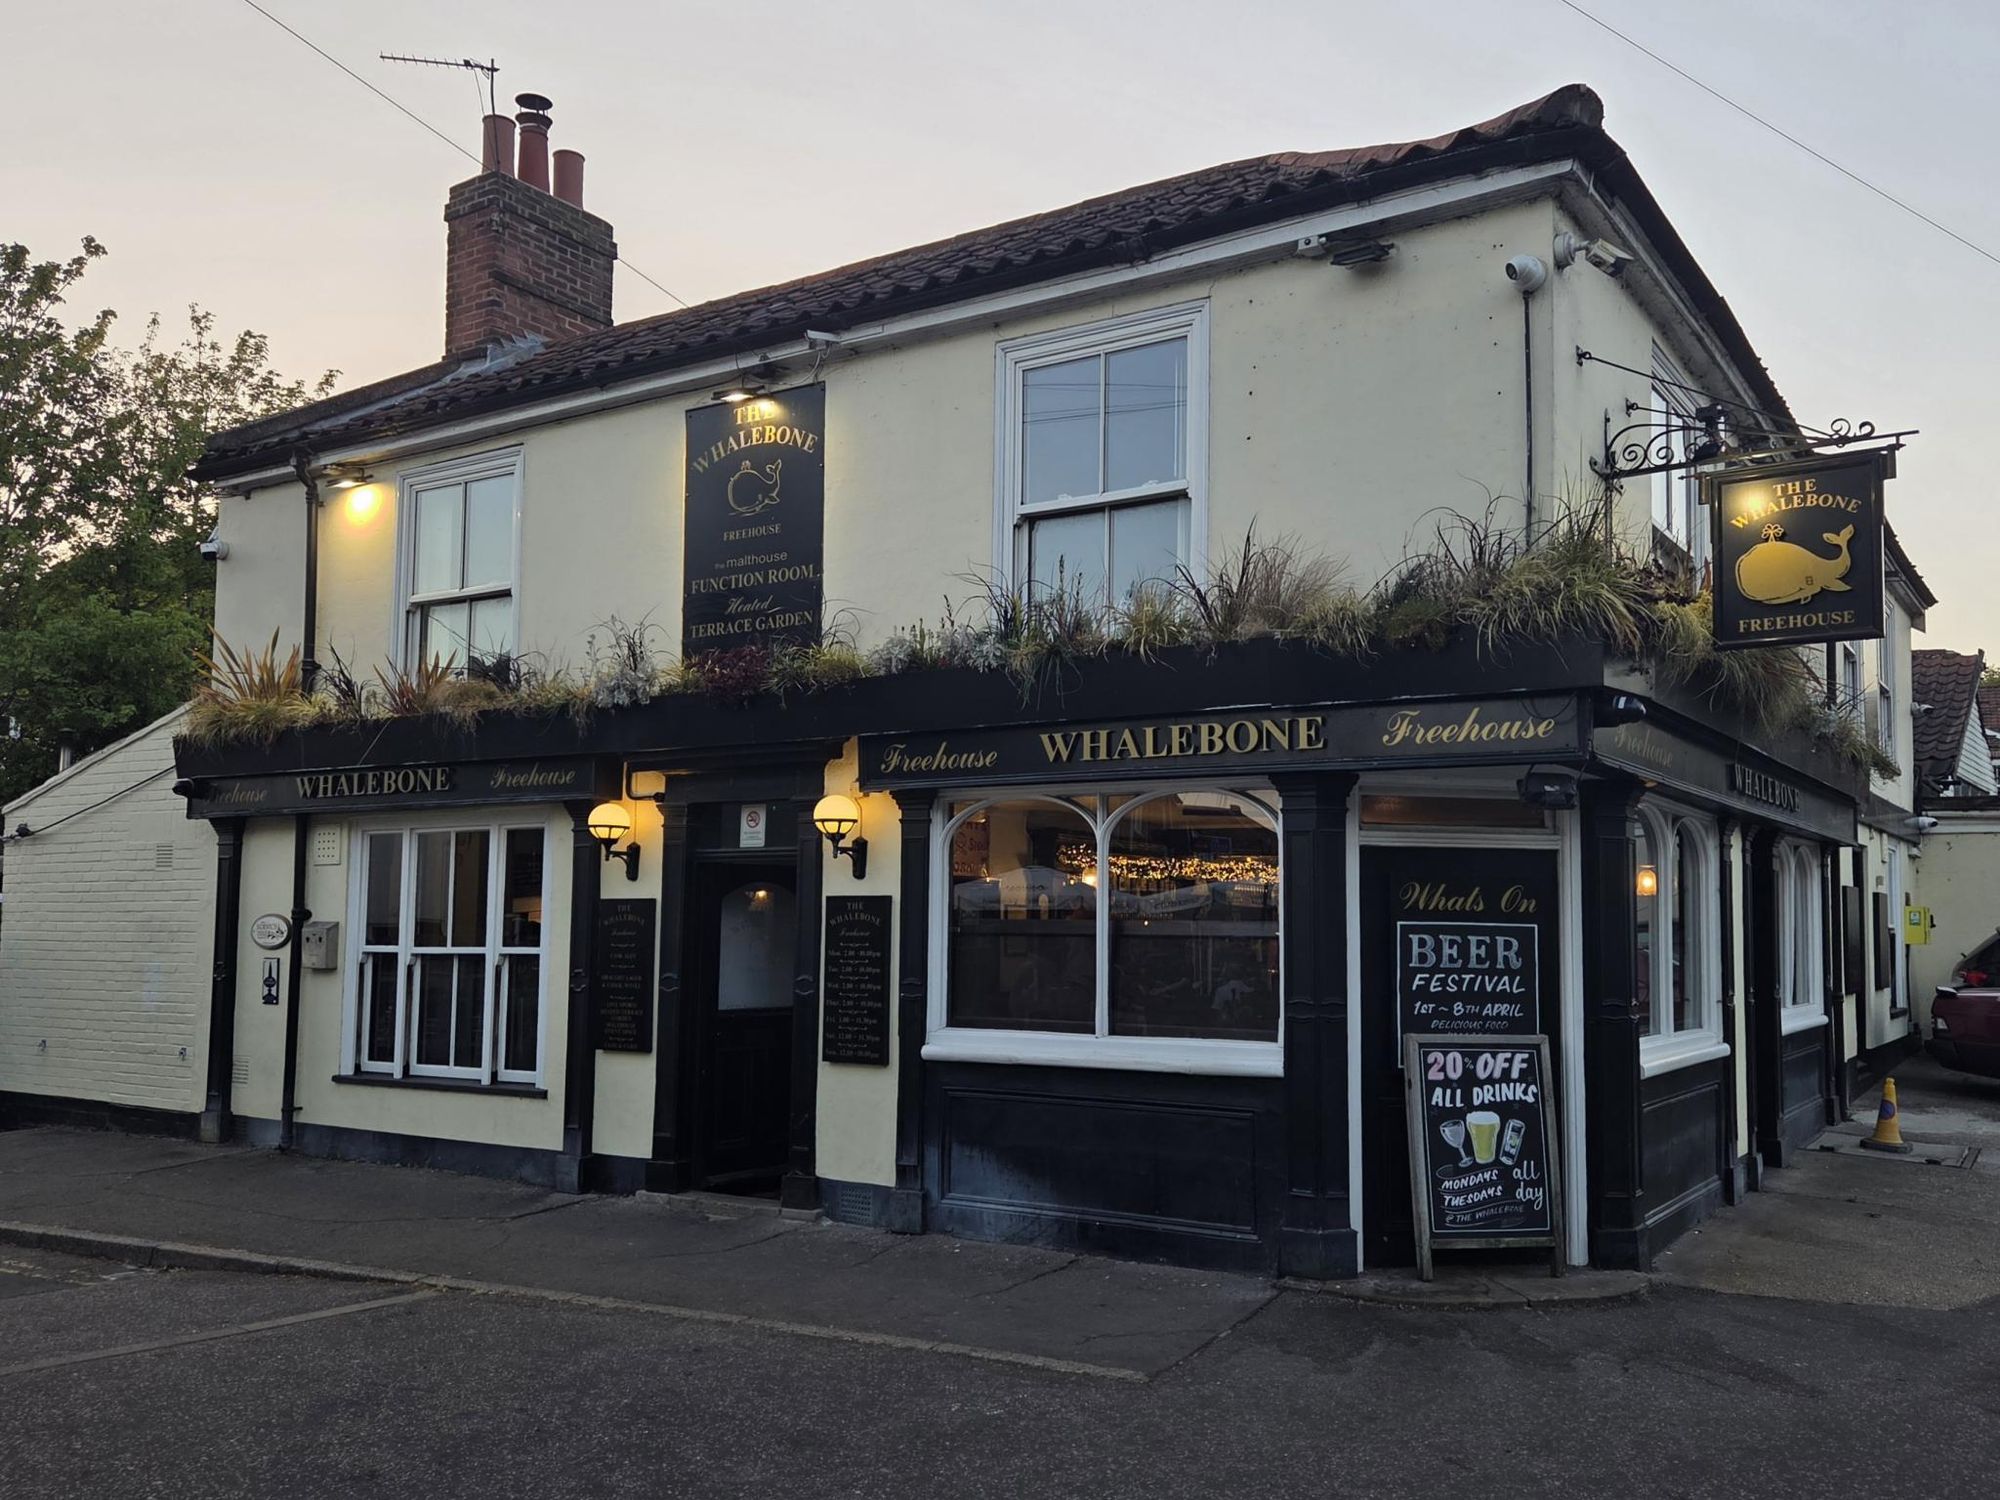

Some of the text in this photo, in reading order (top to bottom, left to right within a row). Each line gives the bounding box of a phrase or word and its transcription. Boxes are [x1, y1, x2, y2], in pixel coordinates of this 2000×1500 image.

[733, 401, 777, 425] THE
[691, 425, 818, 474] WHALEBONE
[1773, 478, 1817, 497] THE
[1730, 493, 1862, 530] WHALEBONE
[723, 523, 782, 541] FREEHOUSE
[726, 551, 788, 568] malthouse
[691, 564, 814, 595] FUNCTION ROOM
[724, 595, 783, 615] Heated
[690, 610, 814, 638] TERRACE GARDEN
[1739, 610, 1856, 633] FREEHOUSE
[1382, 707, 1557, 747] Freehouse
[1038, 716, 1327, 764] WHALEBONE
[880, 743, 999, 774] Freehouse
[296, 767, 451, 799] WHALEBONE
[489, 765, 578, 789] Freehouse
[1734, 763, 1801, 813] WHALEBONE
[847, 901, 864, 911] THE
[1500, 885, 1537, 913] On
[829, 911, 880, 928] WHALEBONE
[1408, 934, 1522, 969] BEER
[1412, 974, 1526, 994] FESTIVAL
[1453, 1002, 1480, 1017] 8TH
[1482, 1003, 1524, 1017] APRIL
[1431, 1019, 1483, 1031] DELICIOUS
[1427, 1051, 1530, 1081] 20% OFF
[1431, 1083, 1538, 1107] ALL DRINKS
[1441, 1169, 1500, 1190] MONDAYS
[1512, 1160, 1541, 1181] all
[1443, 1186, 1504, 1207] TUESDAYS
[1515, 1181, 1544, 1211] day
[1455, 1212, 1472, 1223] THE
